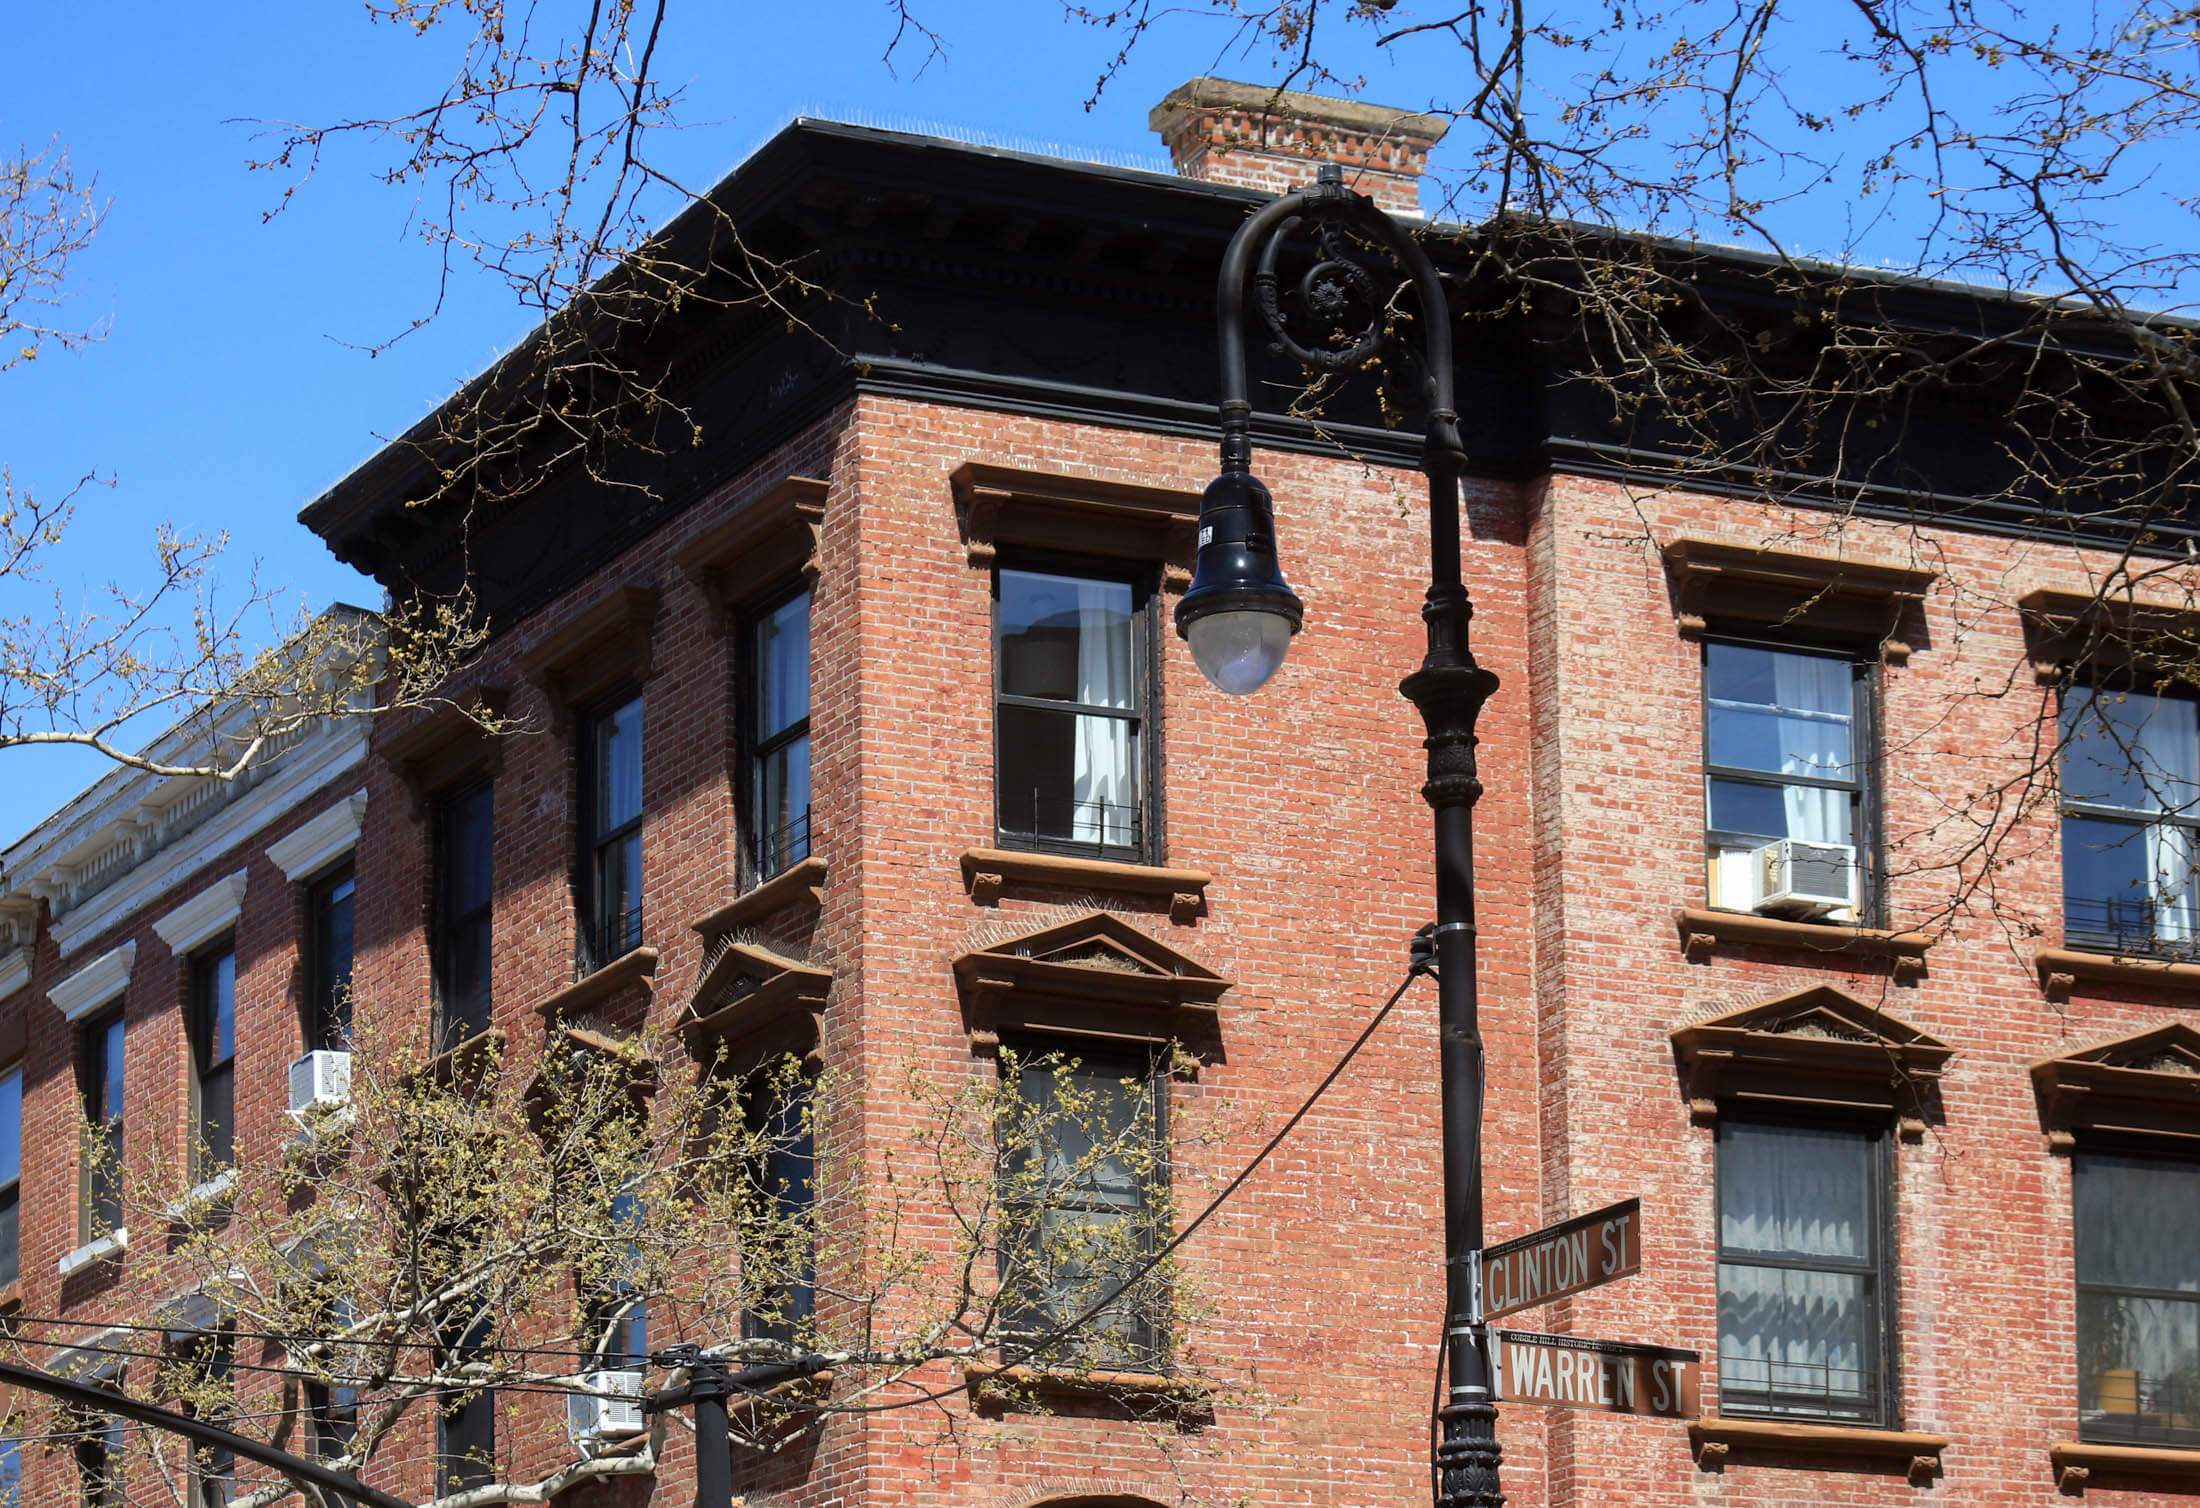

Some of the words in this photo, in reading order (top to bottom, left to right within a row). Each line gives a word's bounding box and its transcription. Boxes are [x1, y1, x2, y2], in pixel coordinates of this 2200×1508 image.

[1488, 1230, 1588, 1311] CLINTON
[1601, 1215, 1630, 1276] ST
[1510, 1333, 1538, 1345] COBBLE
[1539, 1335, 1557, 1346] HILL
[1558, 1337, 1591, 1350] HISTORIC
[1591, 1341, 1623, 1353] DISTRI
[1511, 1345, 1635, 1408] WARREN
[1652, 1359, 1686, 1412] ST
